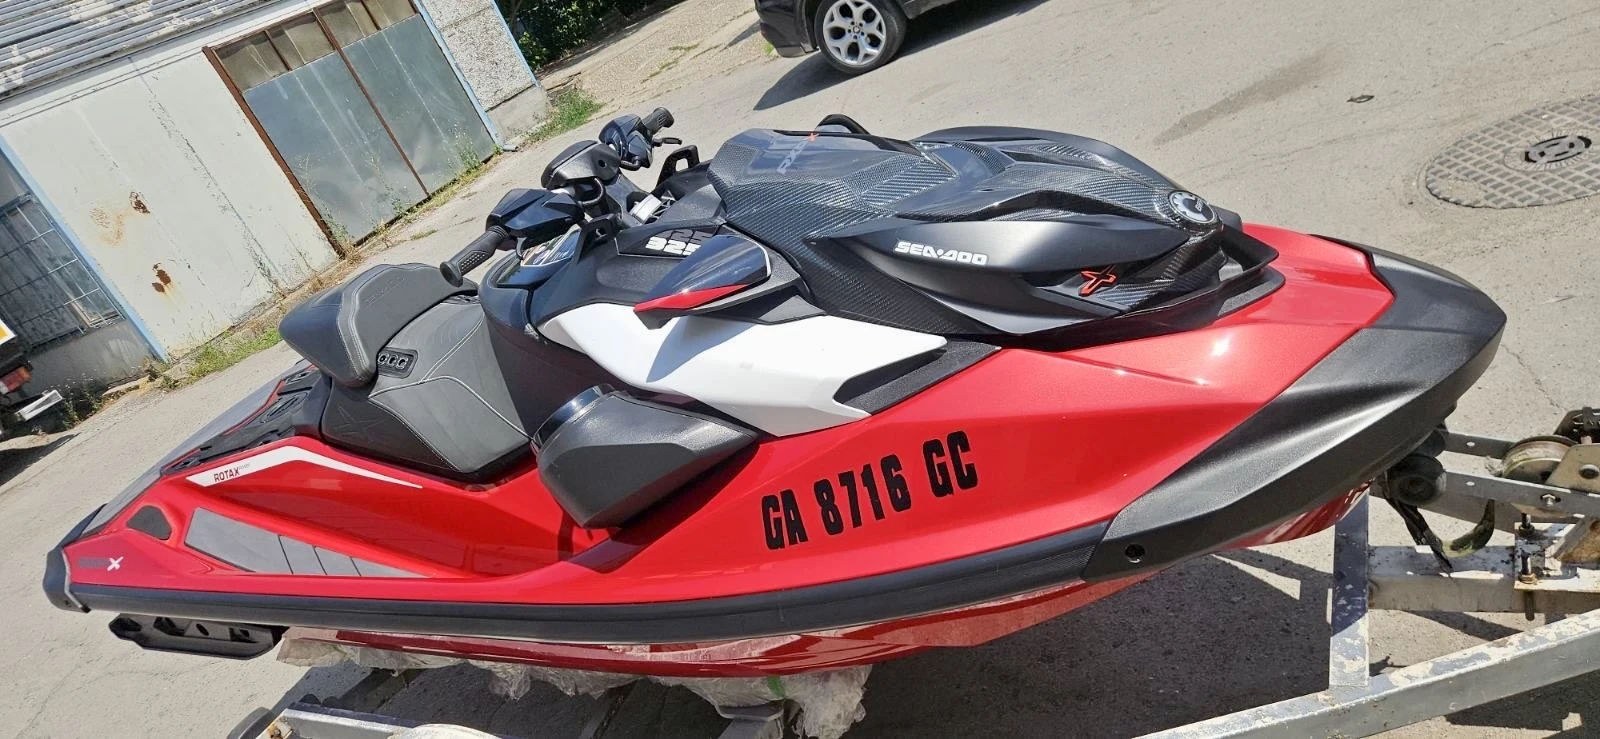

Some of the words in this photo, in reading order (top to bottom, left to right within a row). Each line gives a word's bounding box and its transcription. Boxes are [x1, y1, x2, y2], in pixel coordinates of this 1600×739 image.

[645, 236, 702, 256] 325
[213, 466, 241, 482] ROTAX
[761, 489, 808, 550] GA
[813, 454, 912, 536] 8716
[923, 430, 978, 498] GC
